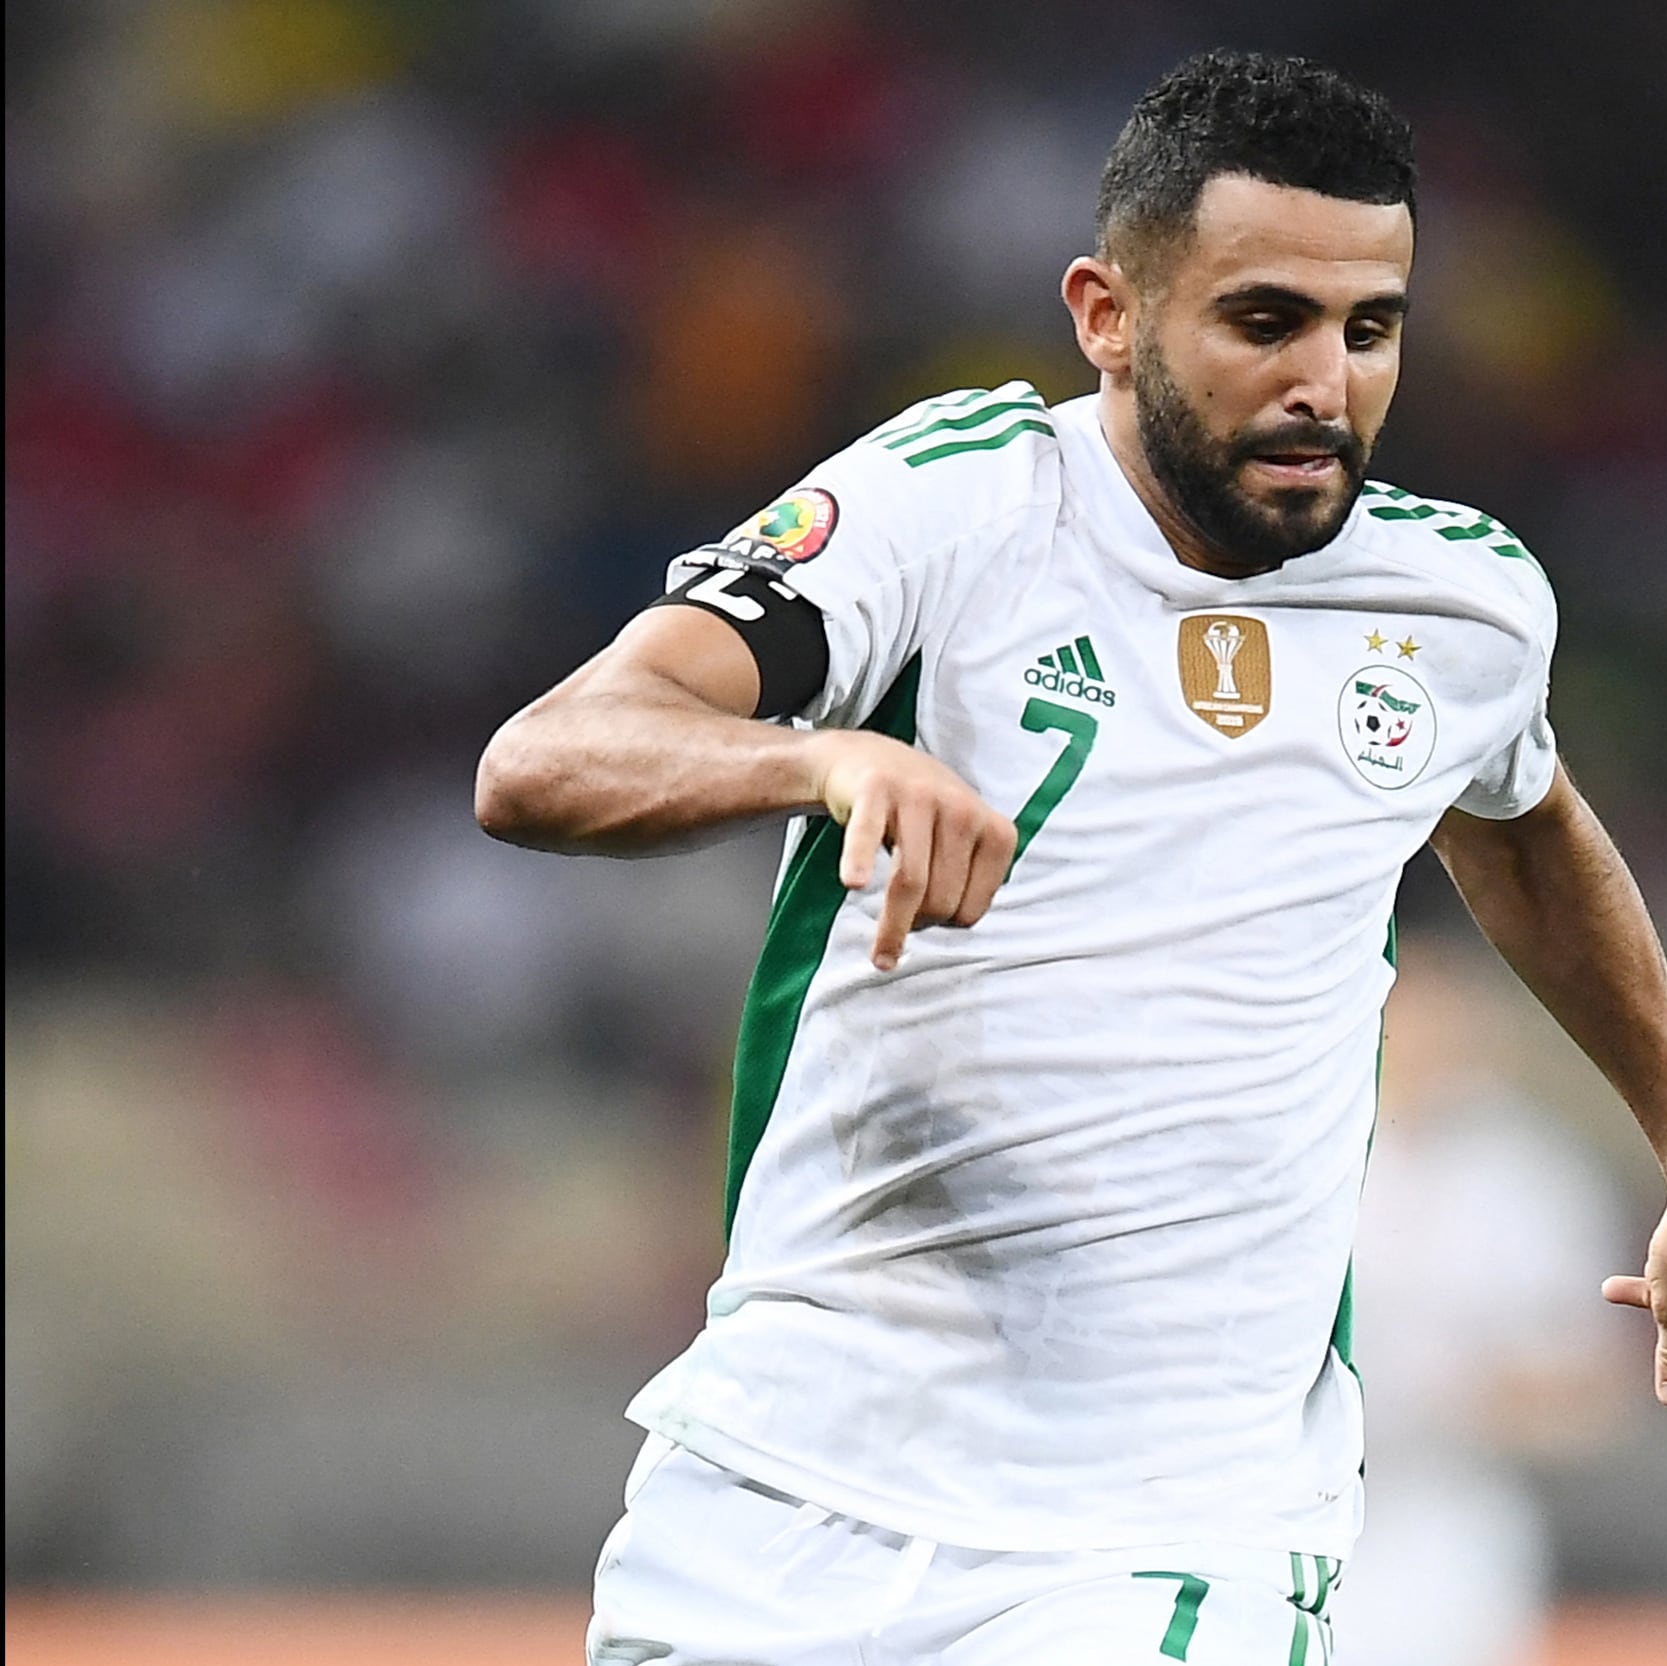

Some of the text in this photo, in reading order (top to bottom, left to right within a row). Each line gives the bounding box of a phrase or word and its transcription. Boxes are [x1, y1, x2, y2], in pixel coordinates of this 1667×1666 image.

[1023, 665, 1116, 709] adidas
[1003, 697, 1099, 884] 7
[1131, 1570, 1210, 1663] 7
